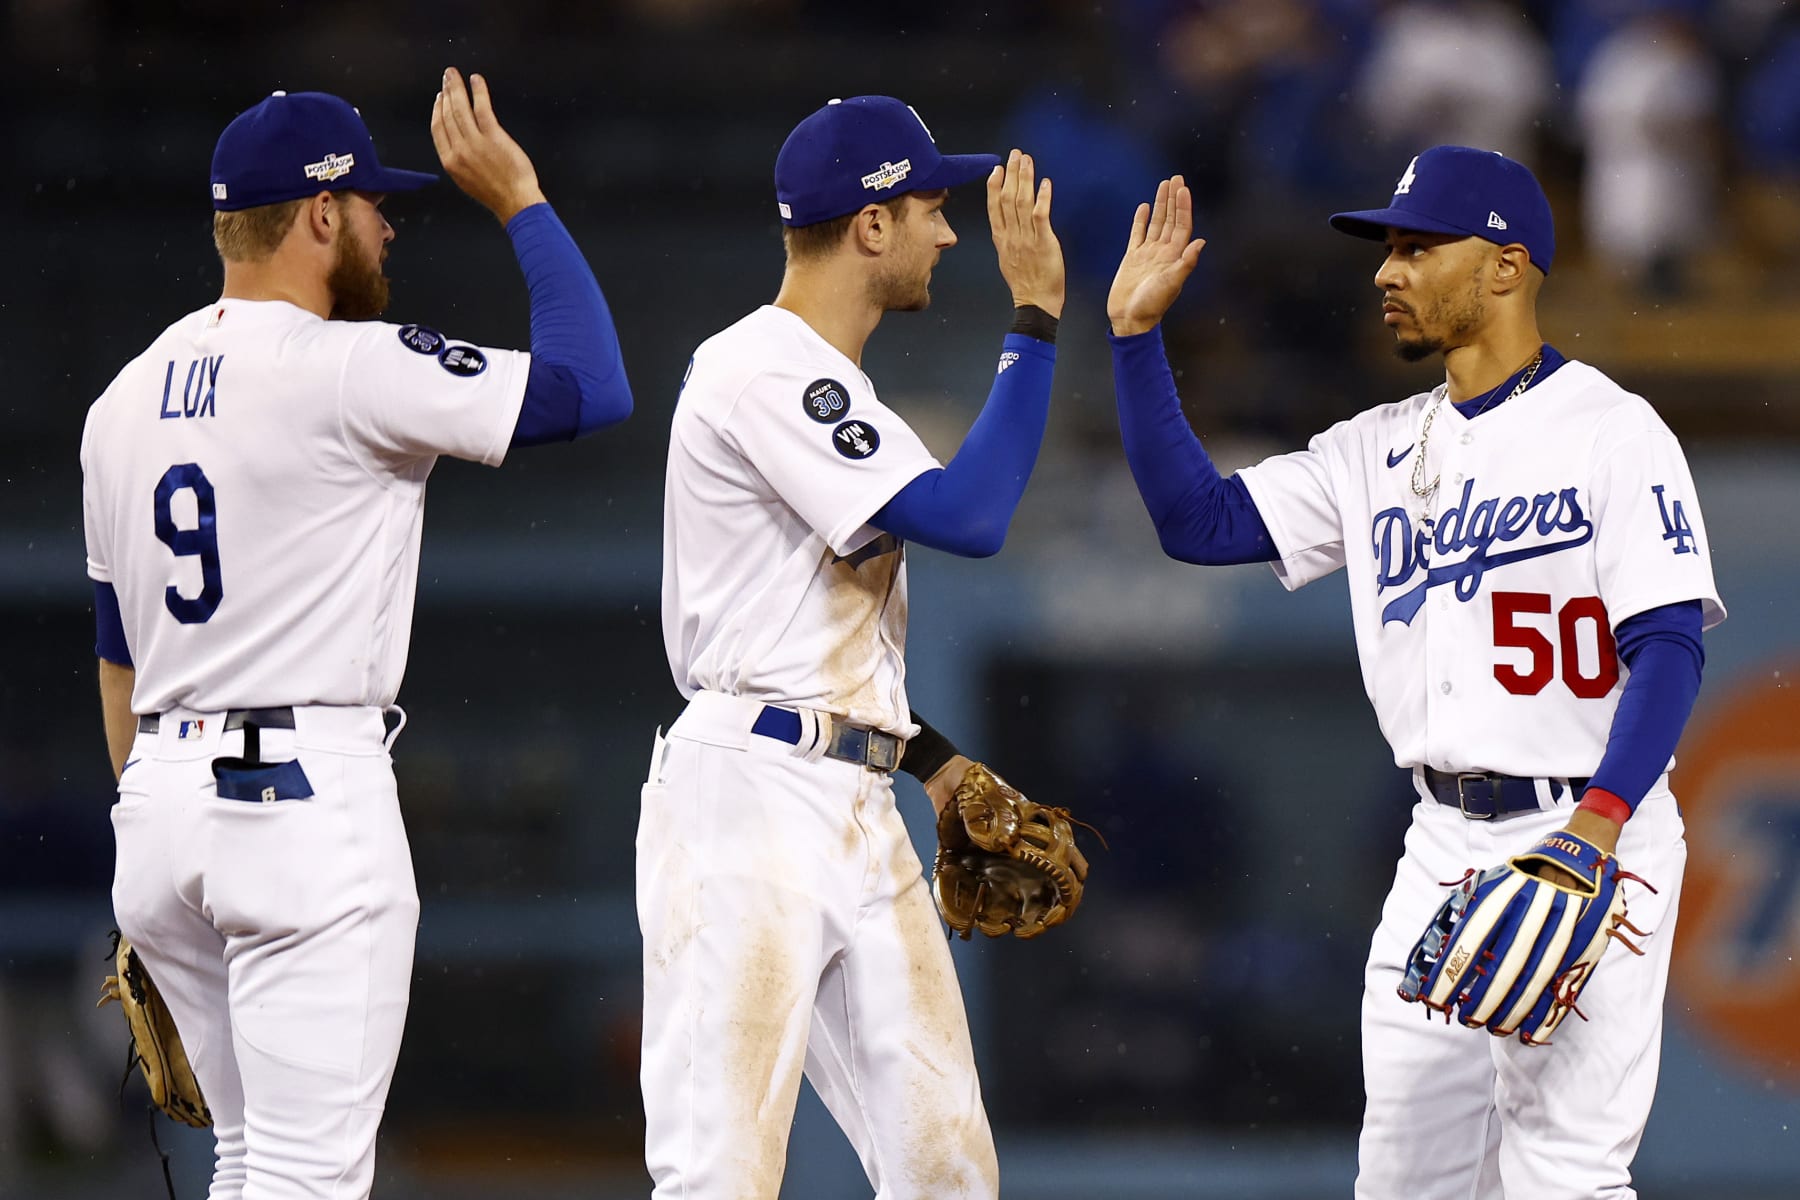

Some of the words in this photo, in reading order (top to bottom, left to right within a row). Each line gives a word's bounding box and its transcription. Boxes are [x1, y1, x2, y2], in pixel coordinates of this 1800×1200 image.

[864, 161, 909, 186] POSTSEASON
[159, 354, 224, 419] LUX
[809, 383, 832, 399] MAURY
[812, 389, 844, 417] 30
[837, 423, 865, 443] VIN
[153, 462, 224, 625] 9
[1372, 477, 1594, 603] Dodgers
[1651, 484, 1700, 556] LA
[1491, 591, 1620, 699] 50
[1445, 945, 1471, 984] A2K
